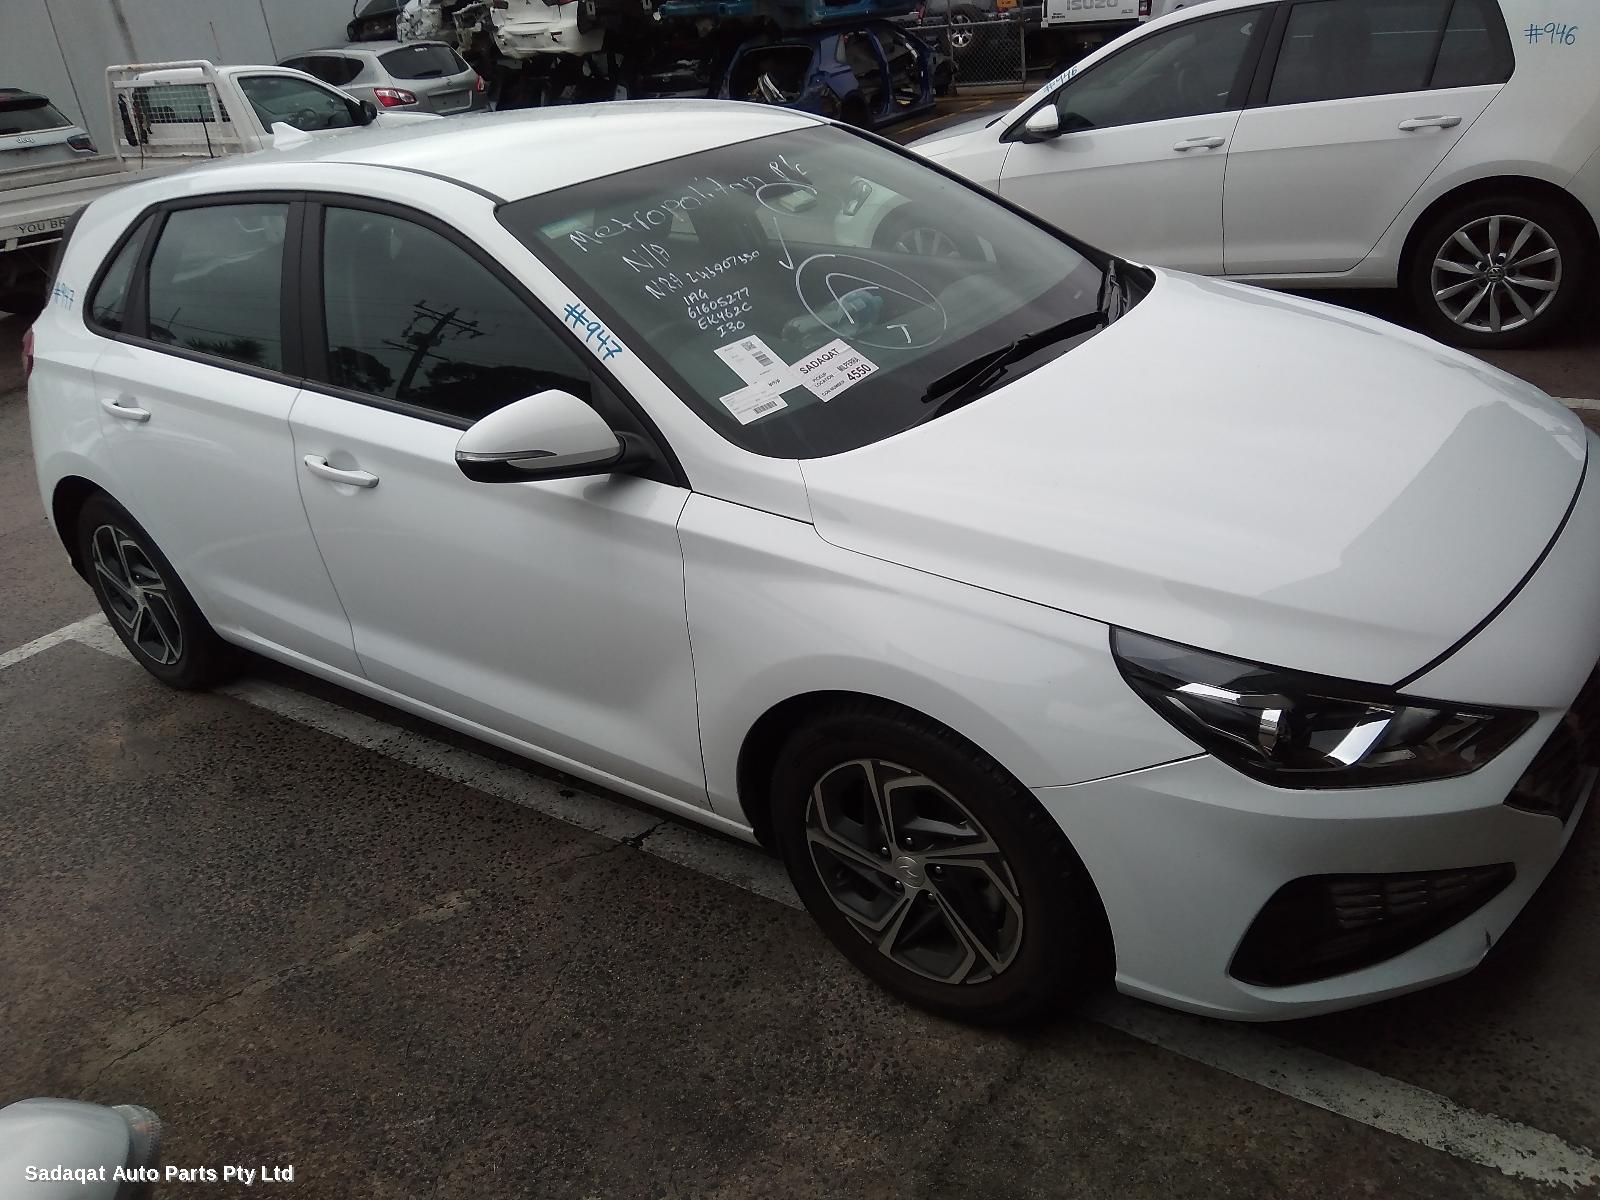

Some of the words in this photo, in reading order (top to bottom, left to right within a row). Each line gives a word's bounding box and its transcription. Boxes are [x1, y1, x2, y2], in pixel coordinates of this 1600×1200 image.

[1523, 22, 1578, 45] #946
[19, 222, 46, 234] YOU
[688, 286, 750, 319] 61605277
[563, 303, 623, 361] #947
[799, 347, 840, 374] SADAQAT
[846, 363, 872, 381] 4550
